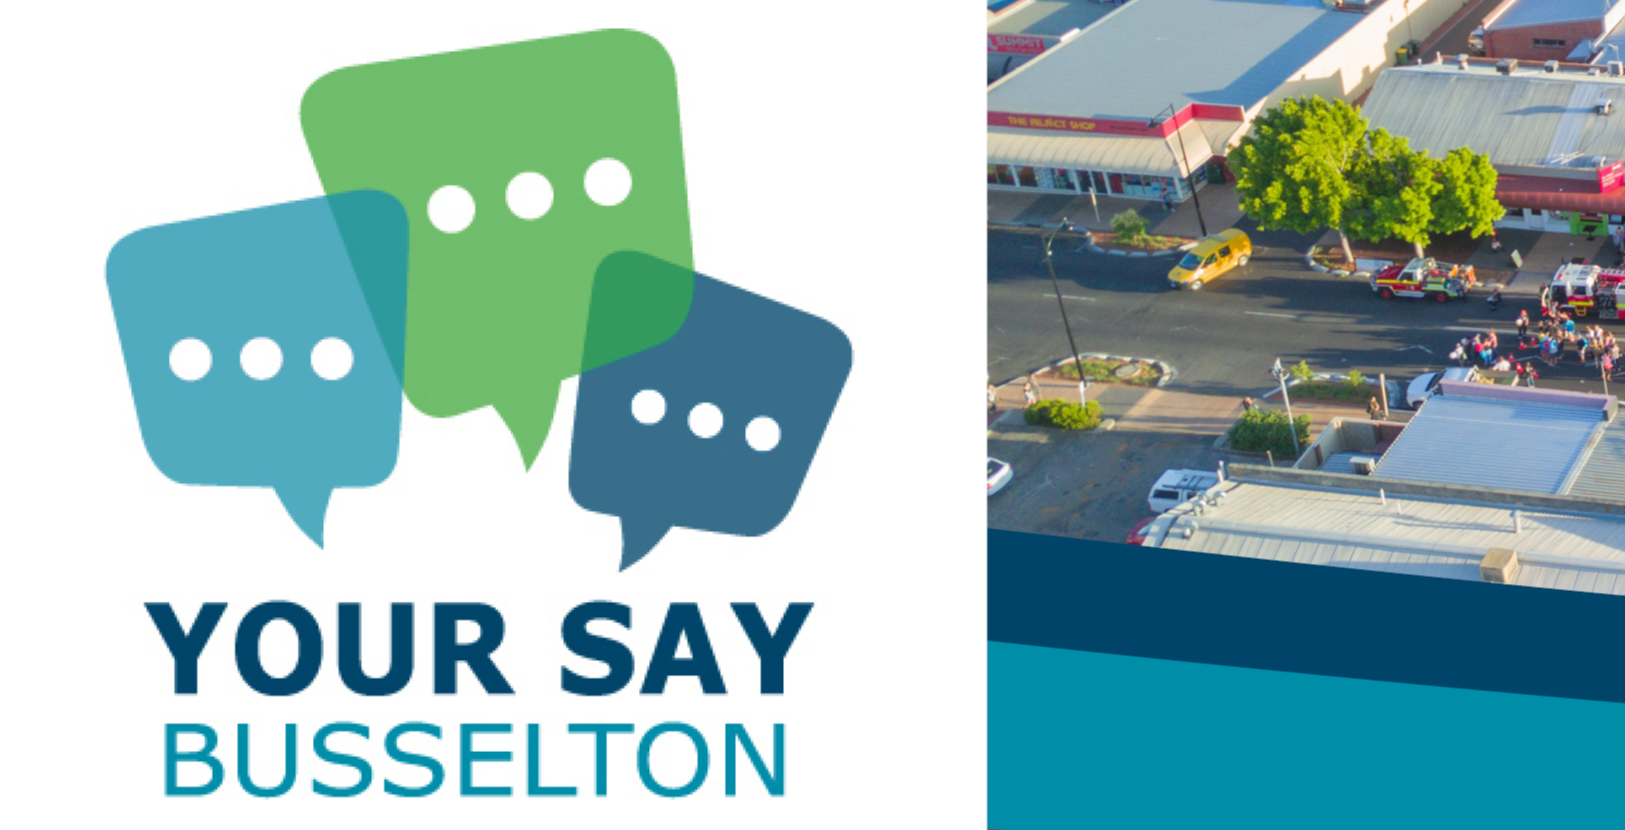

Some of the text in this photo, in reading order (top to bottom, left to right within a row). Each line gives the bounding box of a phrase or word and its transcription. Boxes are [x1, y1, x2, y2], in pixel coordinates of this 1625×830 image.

[996, 36, 1041, 48] SUMMIT
[1007, 116, 1027, 126] THE
[1069, 121, 1096, 131] SHOP
